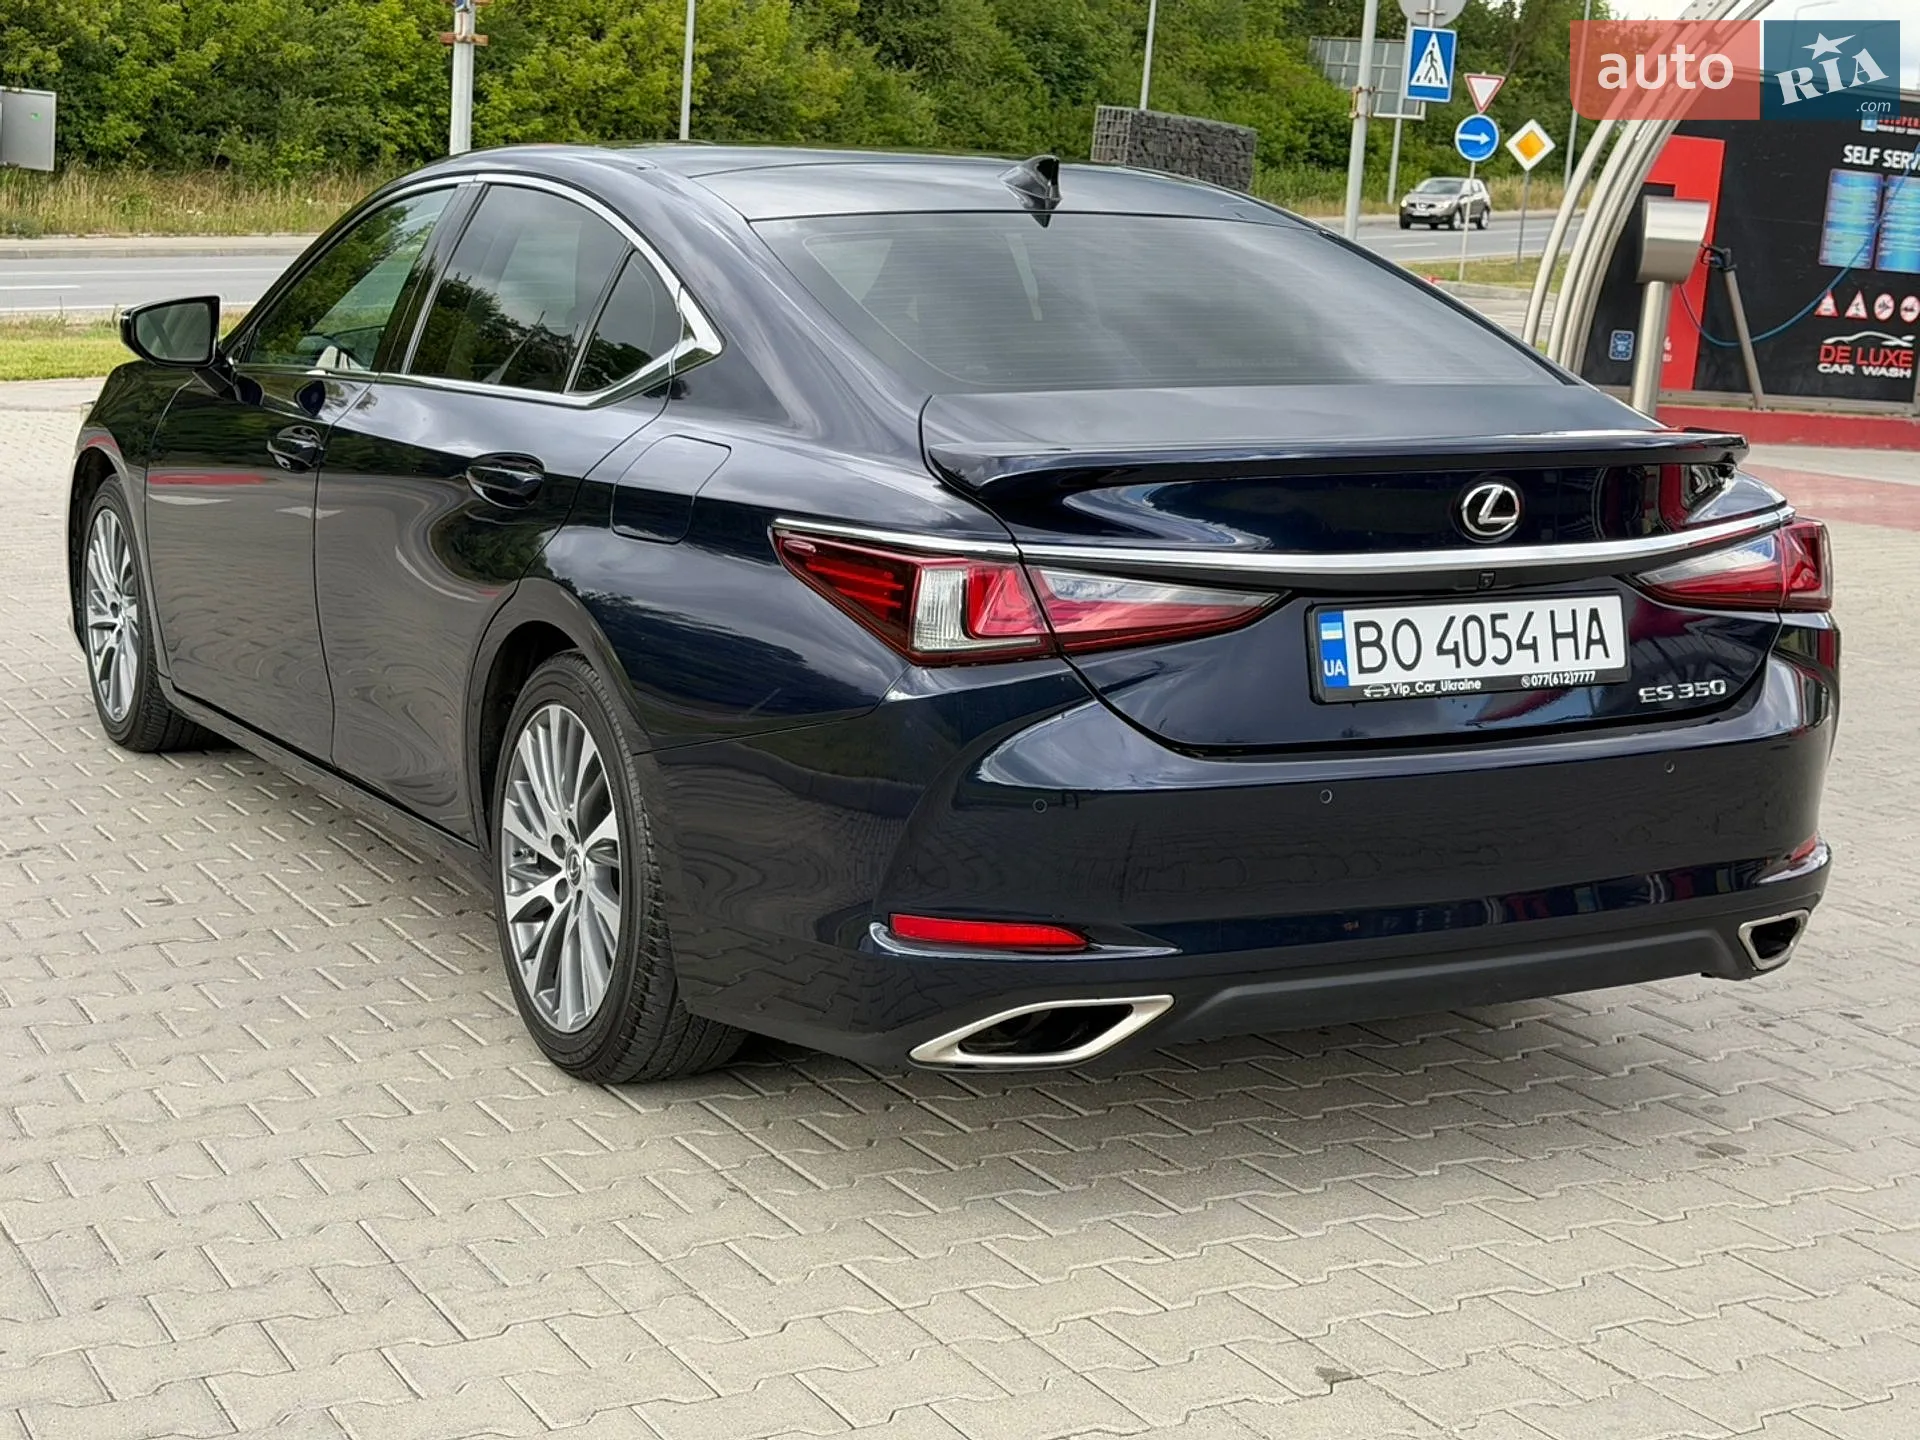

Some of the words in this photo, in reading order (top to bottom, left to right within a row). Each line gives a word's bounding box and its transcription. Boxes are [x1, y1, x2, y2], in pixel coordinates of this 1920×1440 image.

[1842, 144, 1880, 166] SELF
[1882, 148, 1920, 171] SERV
[1819, 345, 1852, 364] DE
[1856, 347, 1914, 369] LUXE
[1816, 363, 1856, 375] CAR
[1862, 365, 1912, 379] WASH
[1353, 617, 1423, 675] BO
[1436, 610, 1540, 669] 4054
[1550, 606, 1611, 662] HA
[1323, 659, 1347, 678] UA
[1638, 684, 1675, 704] ES
[1676, 679, 1727, 699] 350
